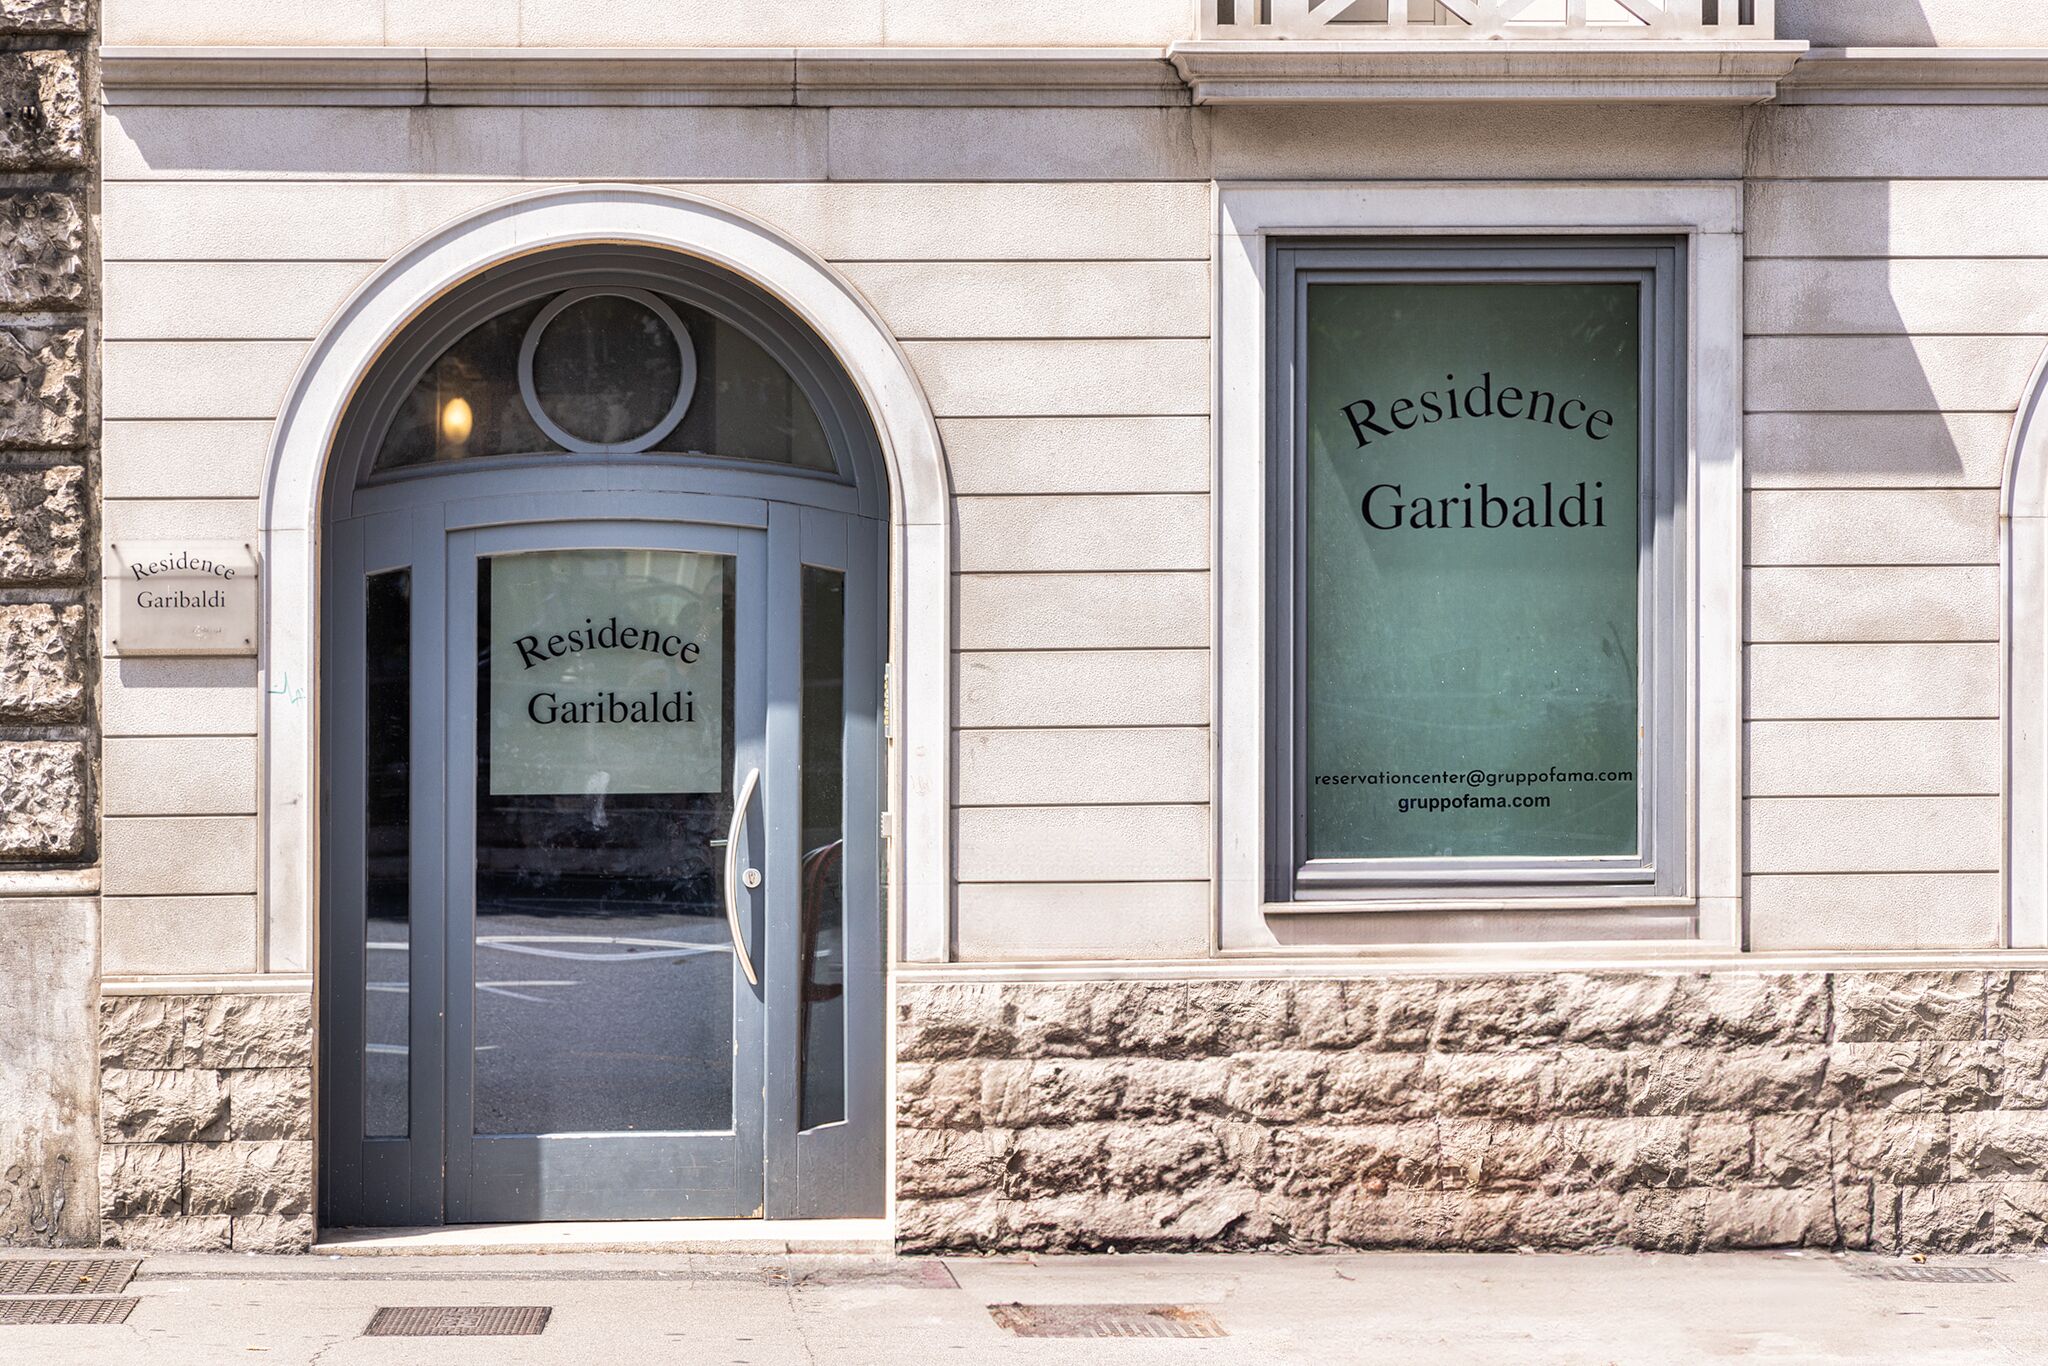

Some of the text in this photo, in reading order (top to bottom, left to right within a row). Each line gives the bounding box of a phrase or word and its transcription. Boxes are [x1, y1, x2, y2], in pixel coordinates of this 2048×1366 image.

[1340, 371, 1613, 449] Residence
[1361, 481, 1607, 530] Garibaldi
[130, 551, 236, 582] Residence
[137, 590, 226, 609] Garibaldi
[512, 616, 701, 671] Residence
[527, 690, 695, 725] Garibaldi
[1315, 766, 1633, 788] reservationcenter@gruppofama.com
[1398, 793, 1551, 813] gruppofama.com
